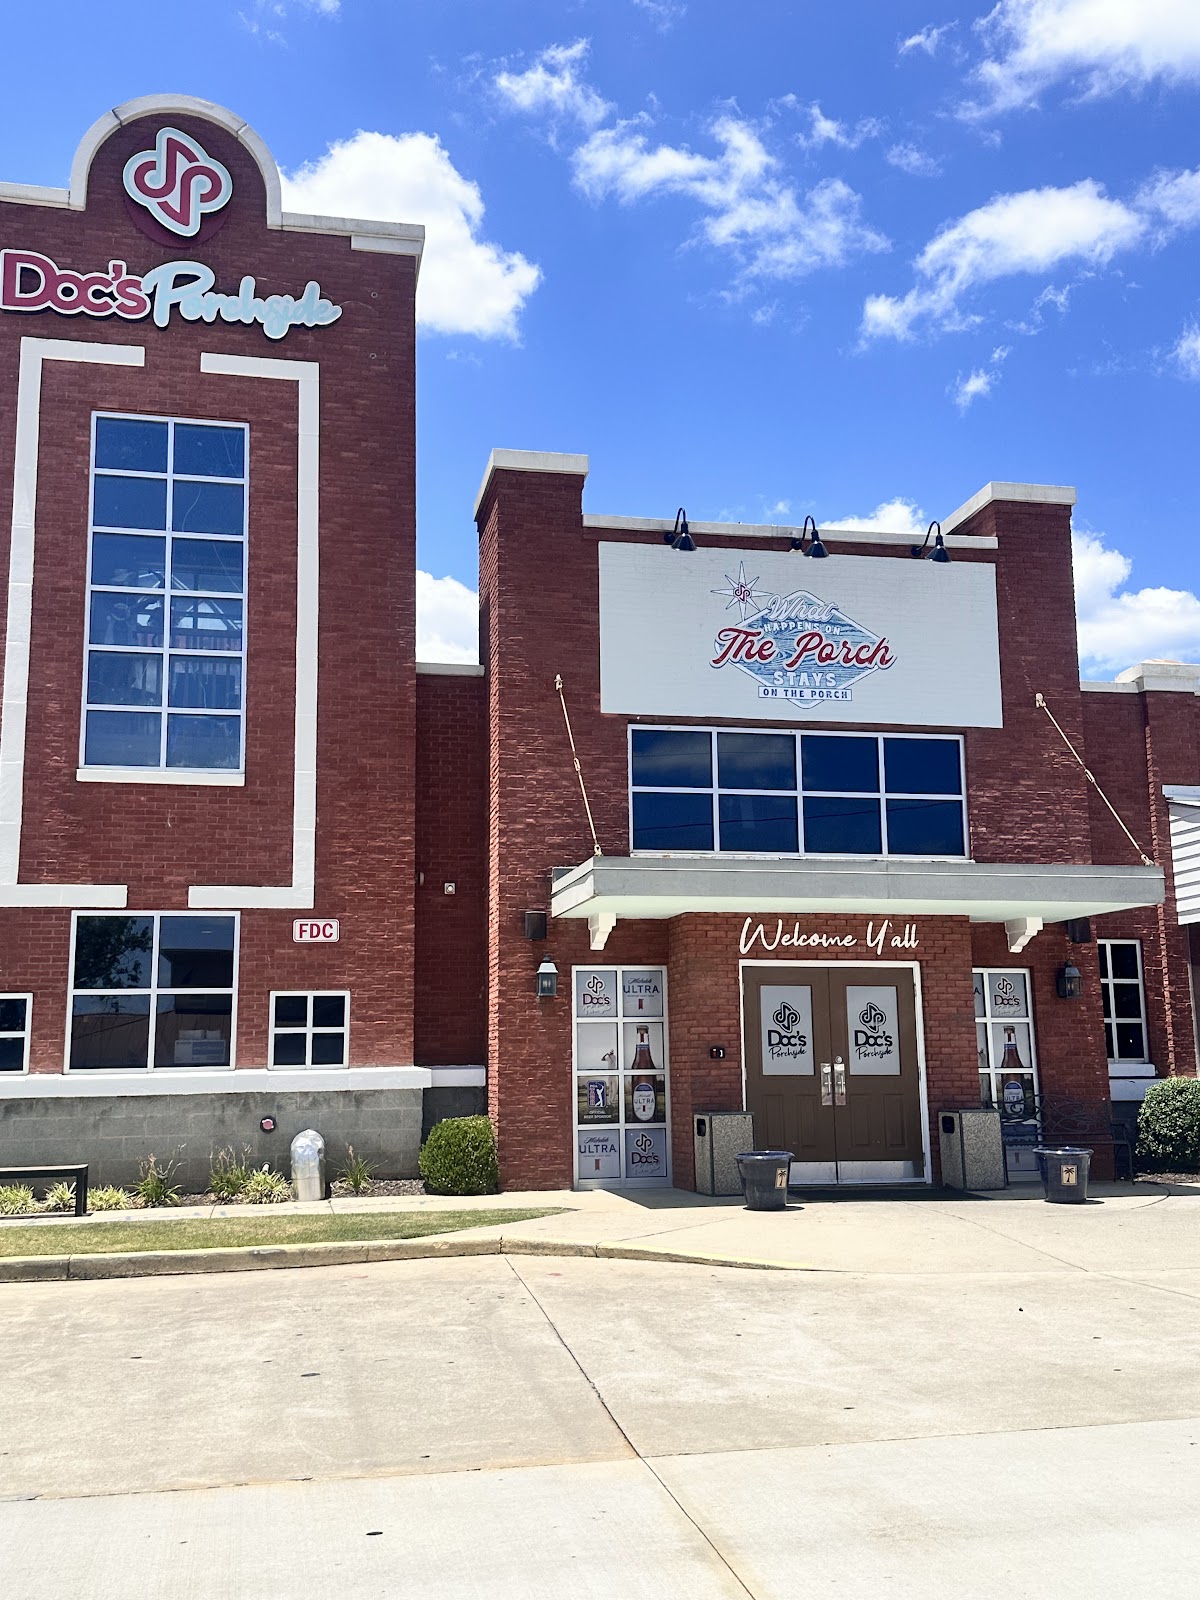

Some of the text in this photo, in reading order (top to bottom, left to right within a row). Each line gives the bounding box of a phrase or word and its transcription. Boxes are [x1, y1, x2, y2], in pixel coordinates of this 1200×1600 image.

[0, 249, 342, 339] Doc's Porchside
[767, 594, 839, 621] What
[764, 621, 841, 635] HAPPENS ON
[711, 627, 896, 668] The Porch
[773, 671, 837, 687] STAYS
[763, 688, 848, 699] ON THE PORCH
[299, 923, 333, 939] FDC
[739, 917, 920, 956] Welcome Y'all
[623, 985, 661, 994] ULTRA
[582, 993, 610, 1005] Doc's
[994, 994, 1020, 1006] Doc's
[768, 1030, 807, 1047] Doc's
[854, 1030, 893, 1047] Doc's
[769, 1046, 807, 1060] Porchside
[855, 1046, 893, 1060] Porchside
[579, 1143, 617, 1154] ULTRA
[631, 1151, 659, 1164] Doc's
